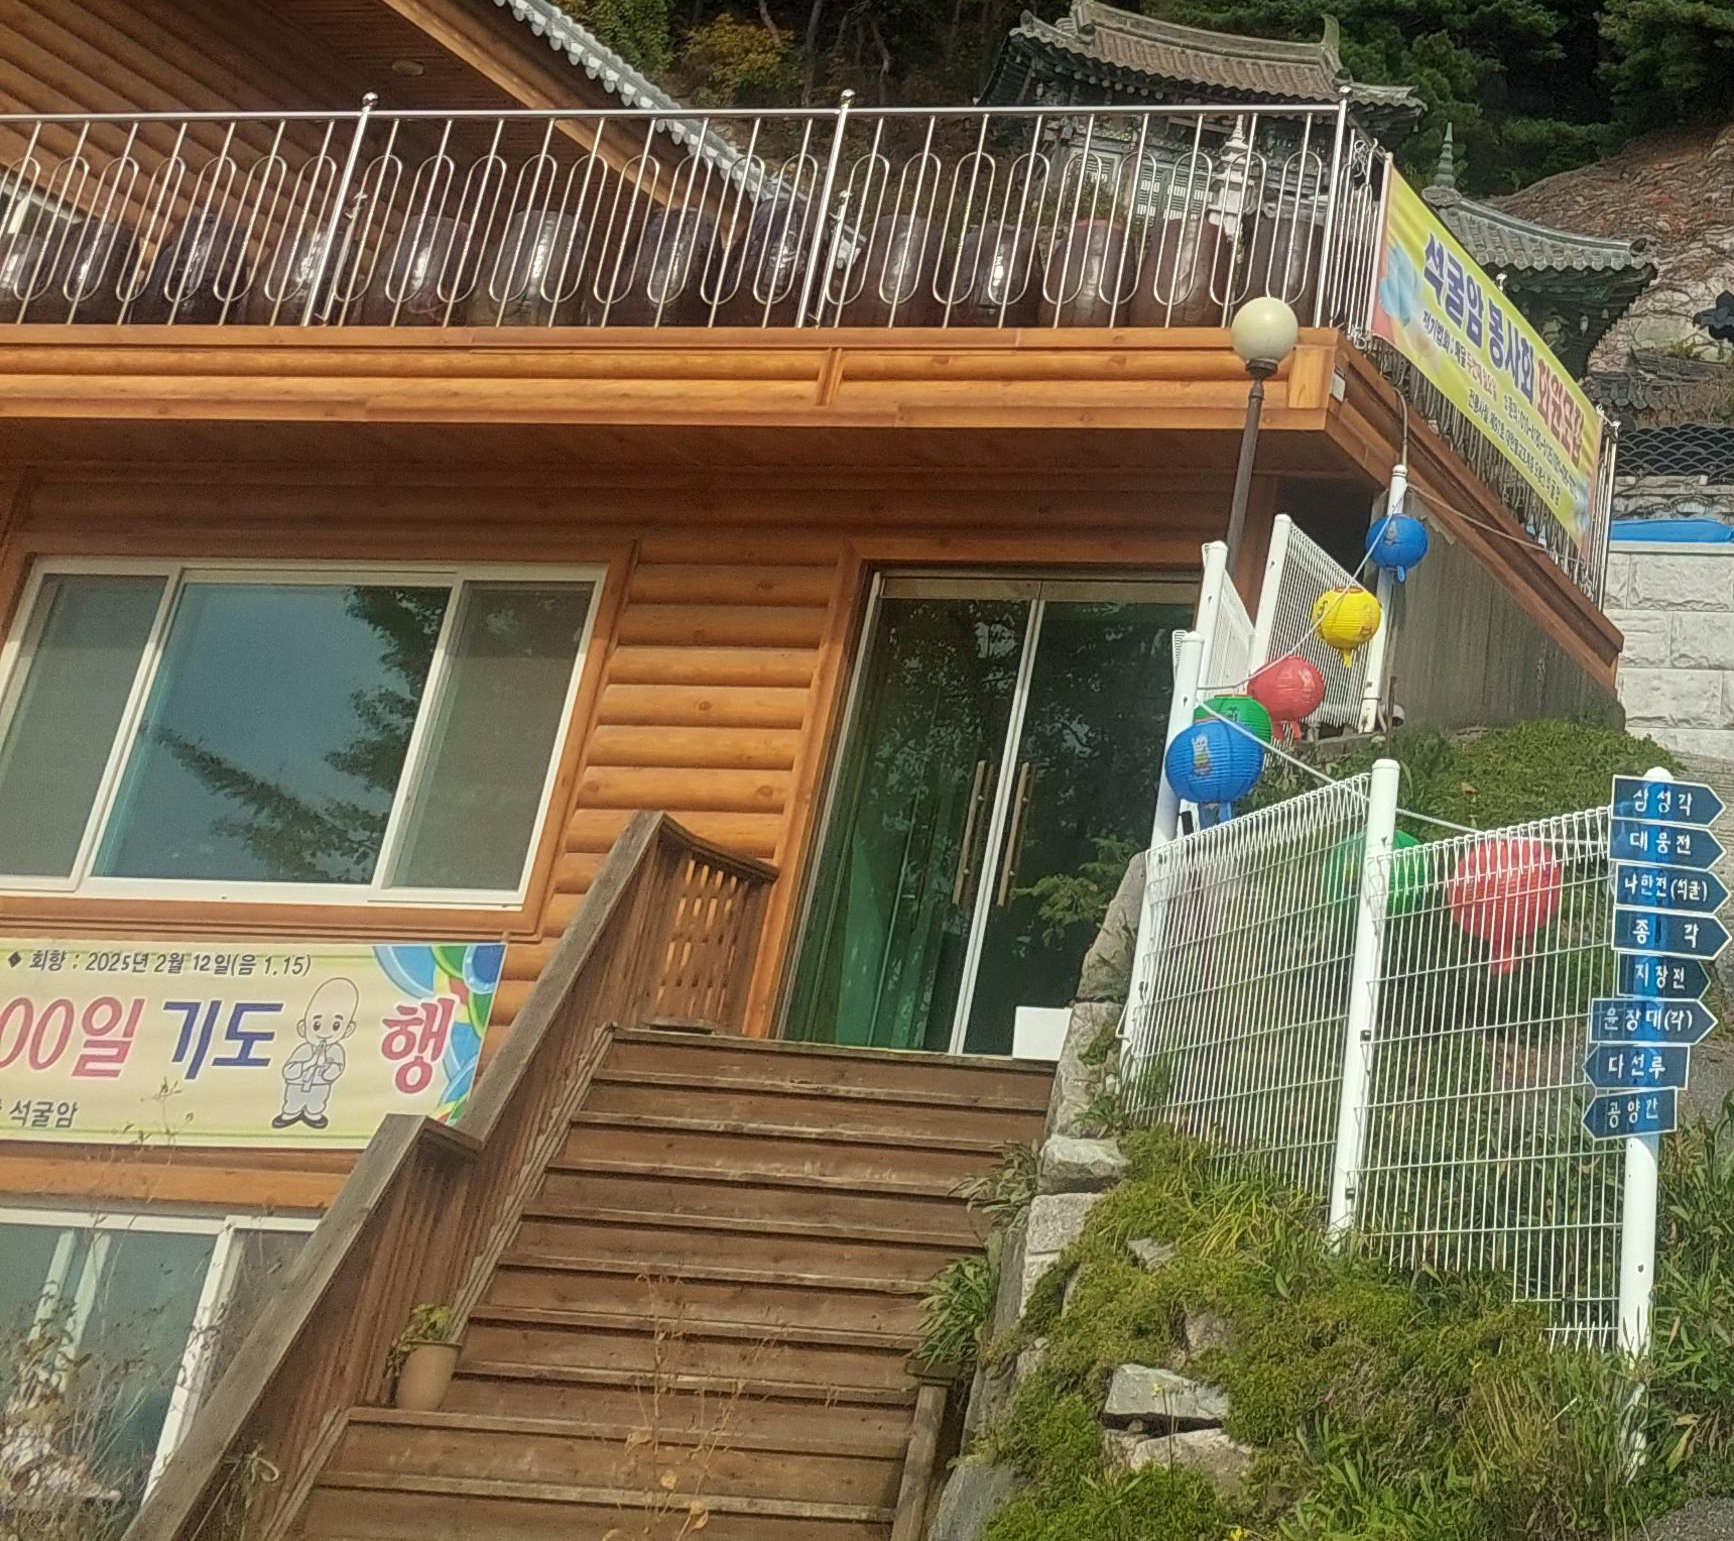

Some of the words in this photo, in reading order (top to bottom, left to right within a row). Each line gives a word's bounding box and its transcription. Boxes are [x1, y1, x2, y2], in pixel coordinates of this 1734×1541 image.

[1424, 232, 1482, 348] 석굴암
[1489, 298, 1534, 405] 봉사회
[1633, 789, 1692, 816] 삼성각
[1630, 831, 1691, 855] 대웅전
[30, 950, 66, 971] 회향
[85, 952, 149, 973] 2025년
[154, 952, 185, 974] 2월
[193, 953, 256, 976] 12일(음
[265, 954, 311, 977] 1.15)
[1635, 962, 1685, 990] 지장전
[1604, 1007, 1692, 1031] 윤장대(각)
[163, 1000, 284, 1080] 기도
[380, 995, 455, 1094] 행
[1608, 1053, 1666, 1079] 다선루
[9, 1100, 78, 1128] 석굴암
[1608, 1097, 1658, 1128] 공양간
